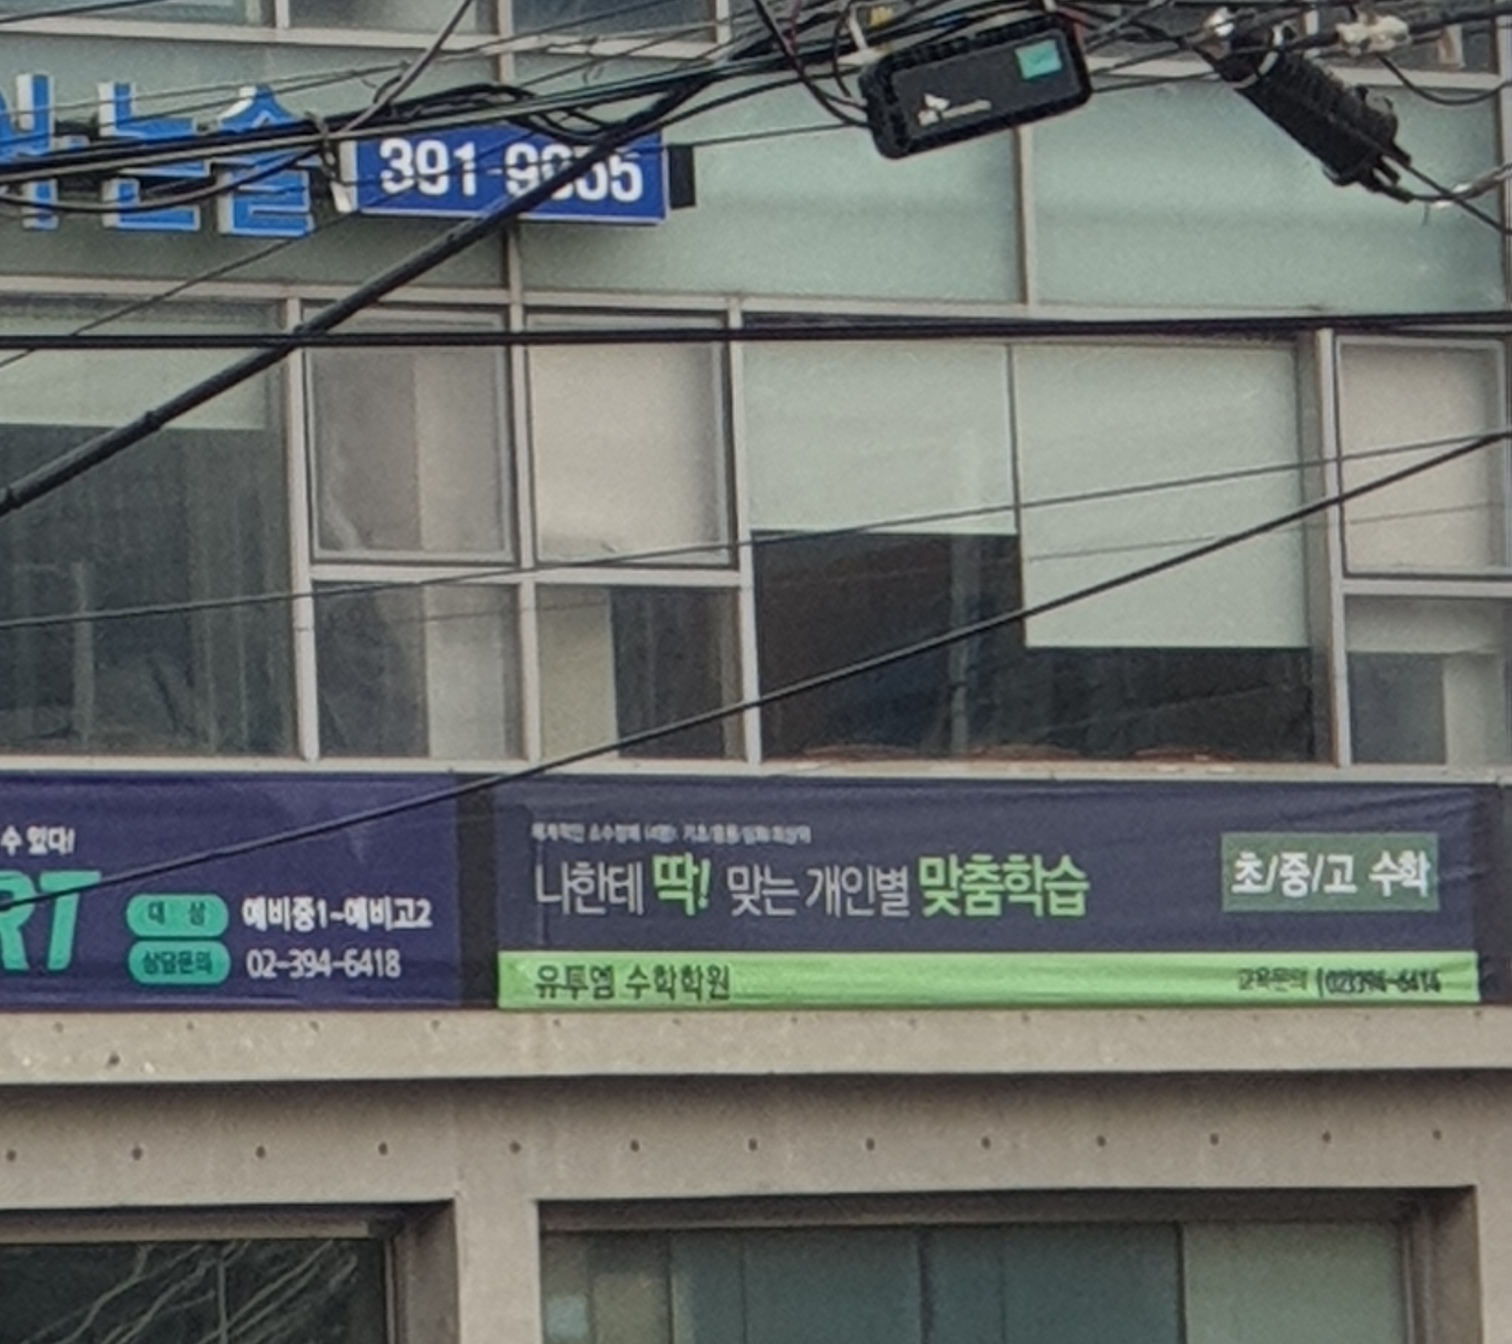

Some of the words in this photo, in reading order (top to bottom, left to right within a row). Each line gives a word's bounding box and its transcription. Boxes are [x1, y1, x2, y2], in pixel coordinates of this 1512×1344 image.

[536, 861, 644, 915] 나한테
[652, 852, 711, 916] 딱!
[726, 864, 801, 916] 맞는
[805, 864, 911, 918] 개인별
[918, 852, 1091, 918] 맞춤학습
[1368, 850, 1431, 897] 수학
[246, 948, 402, 978] 02-394-6418
[535, 965, 615, 999] 유투엠
[625, 965, 731, 1001] 수학학원
